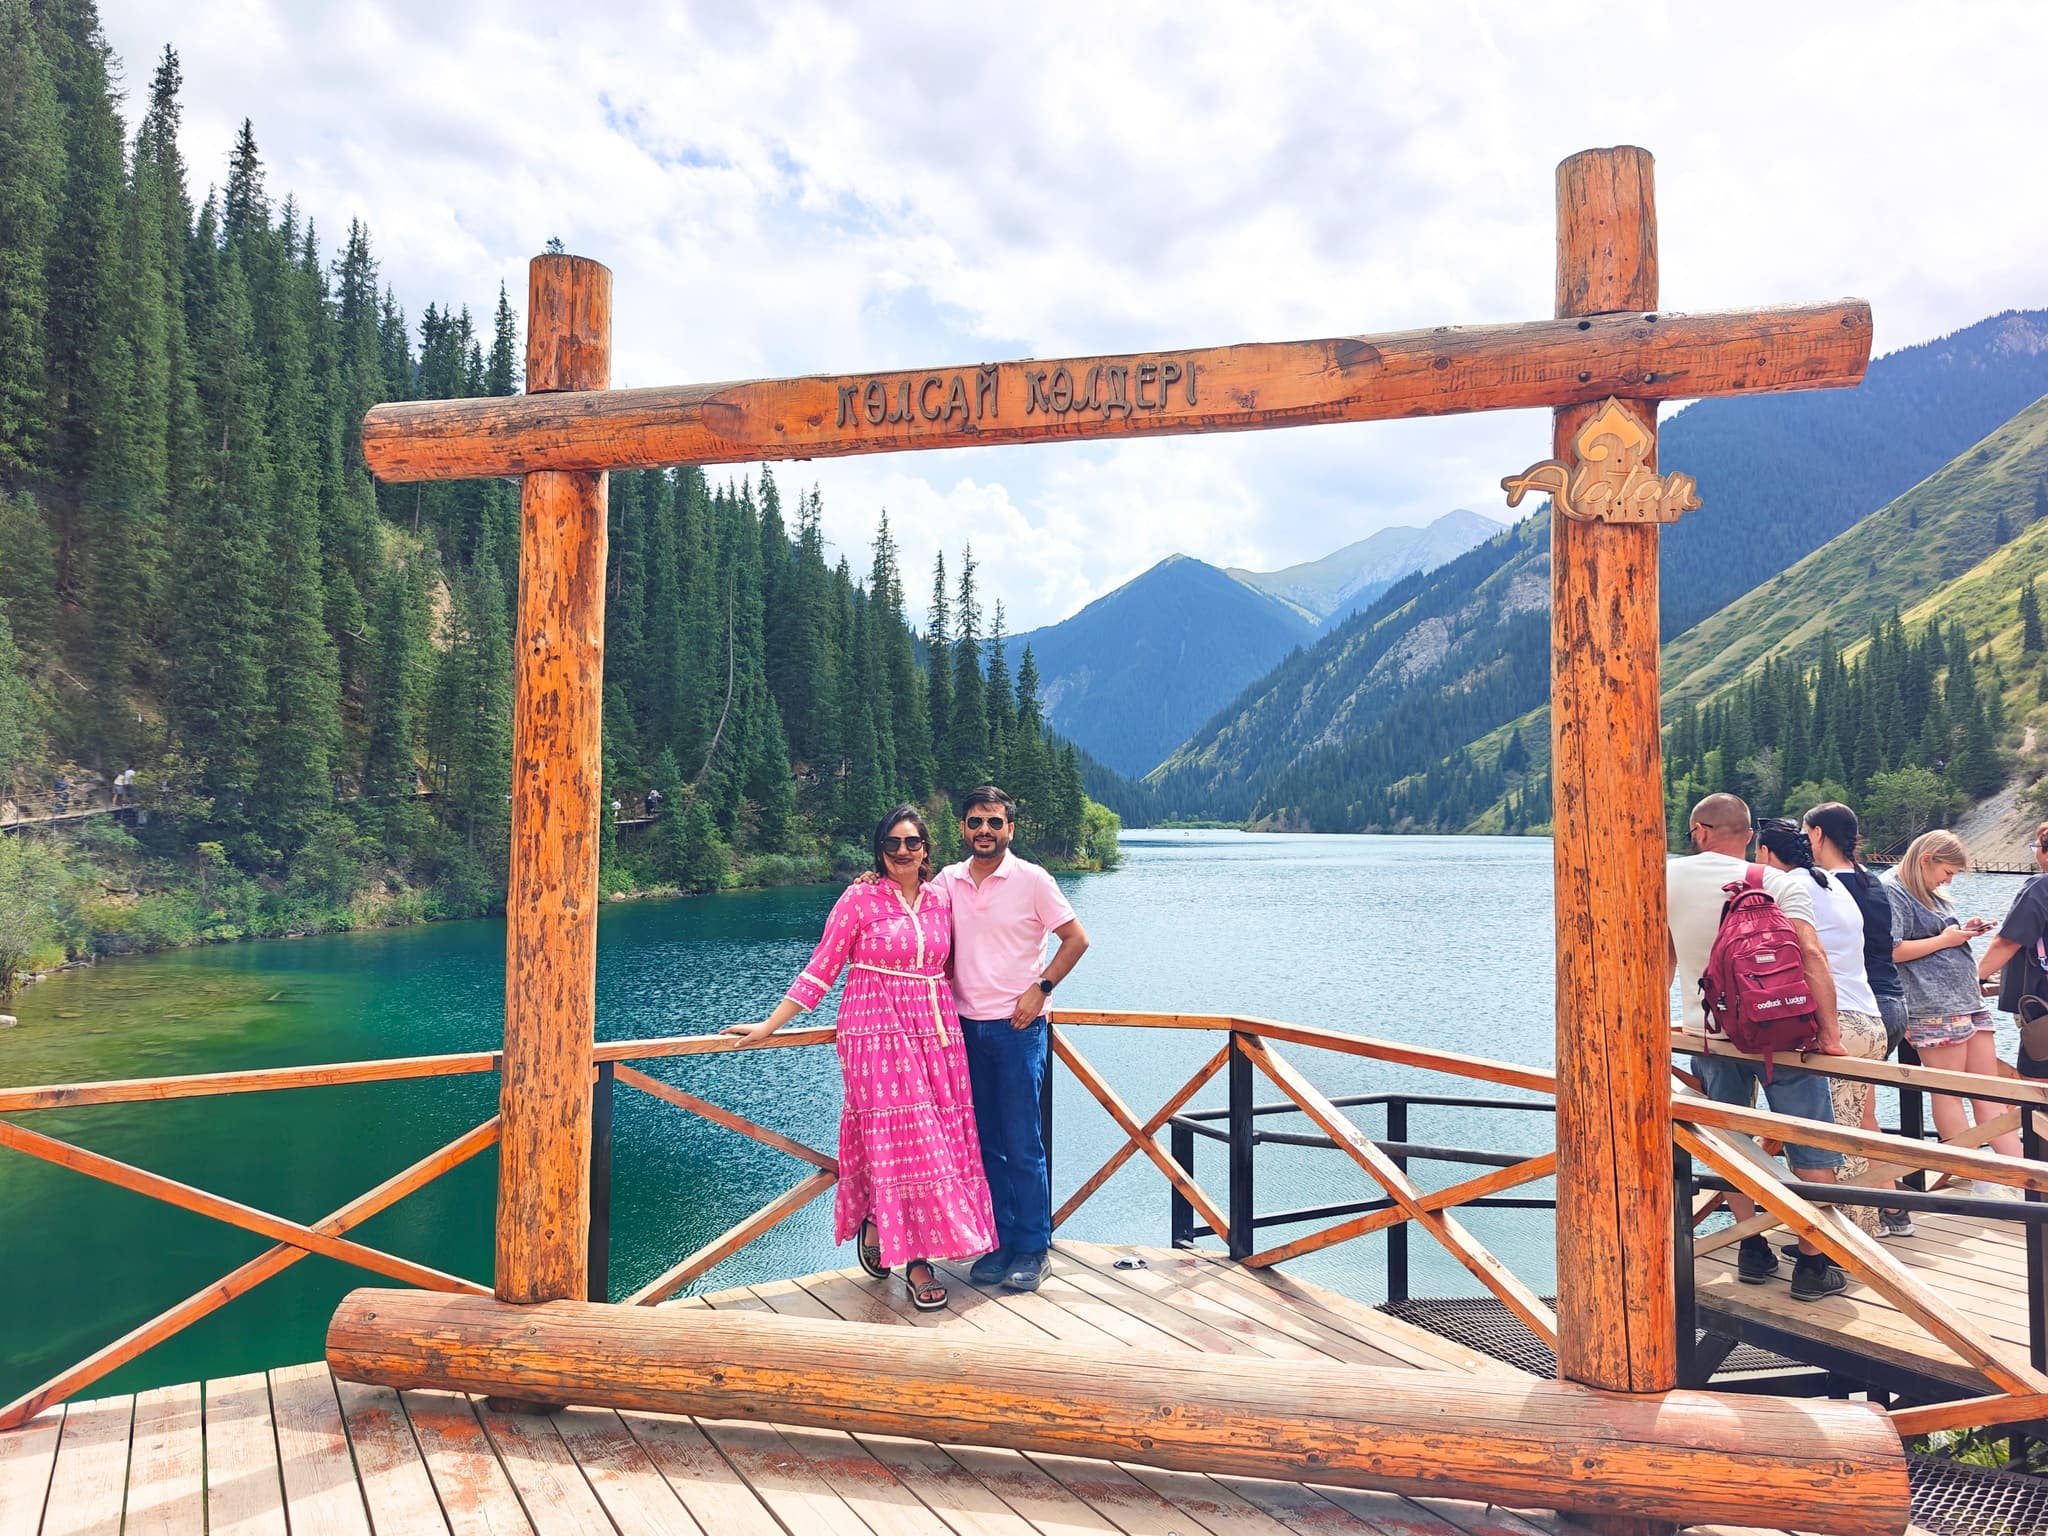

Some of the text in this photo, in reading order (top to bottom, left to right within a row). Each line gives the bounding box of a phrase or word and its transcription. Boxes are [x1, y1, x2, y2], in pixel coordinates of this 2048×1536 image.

[835, 361, 1197, 427] КӨЛСАЙ КӨЛДЕРІ
[1506, 465, 1697, 518] Alatau
[1606, 508, 1676, 518] VISIT
